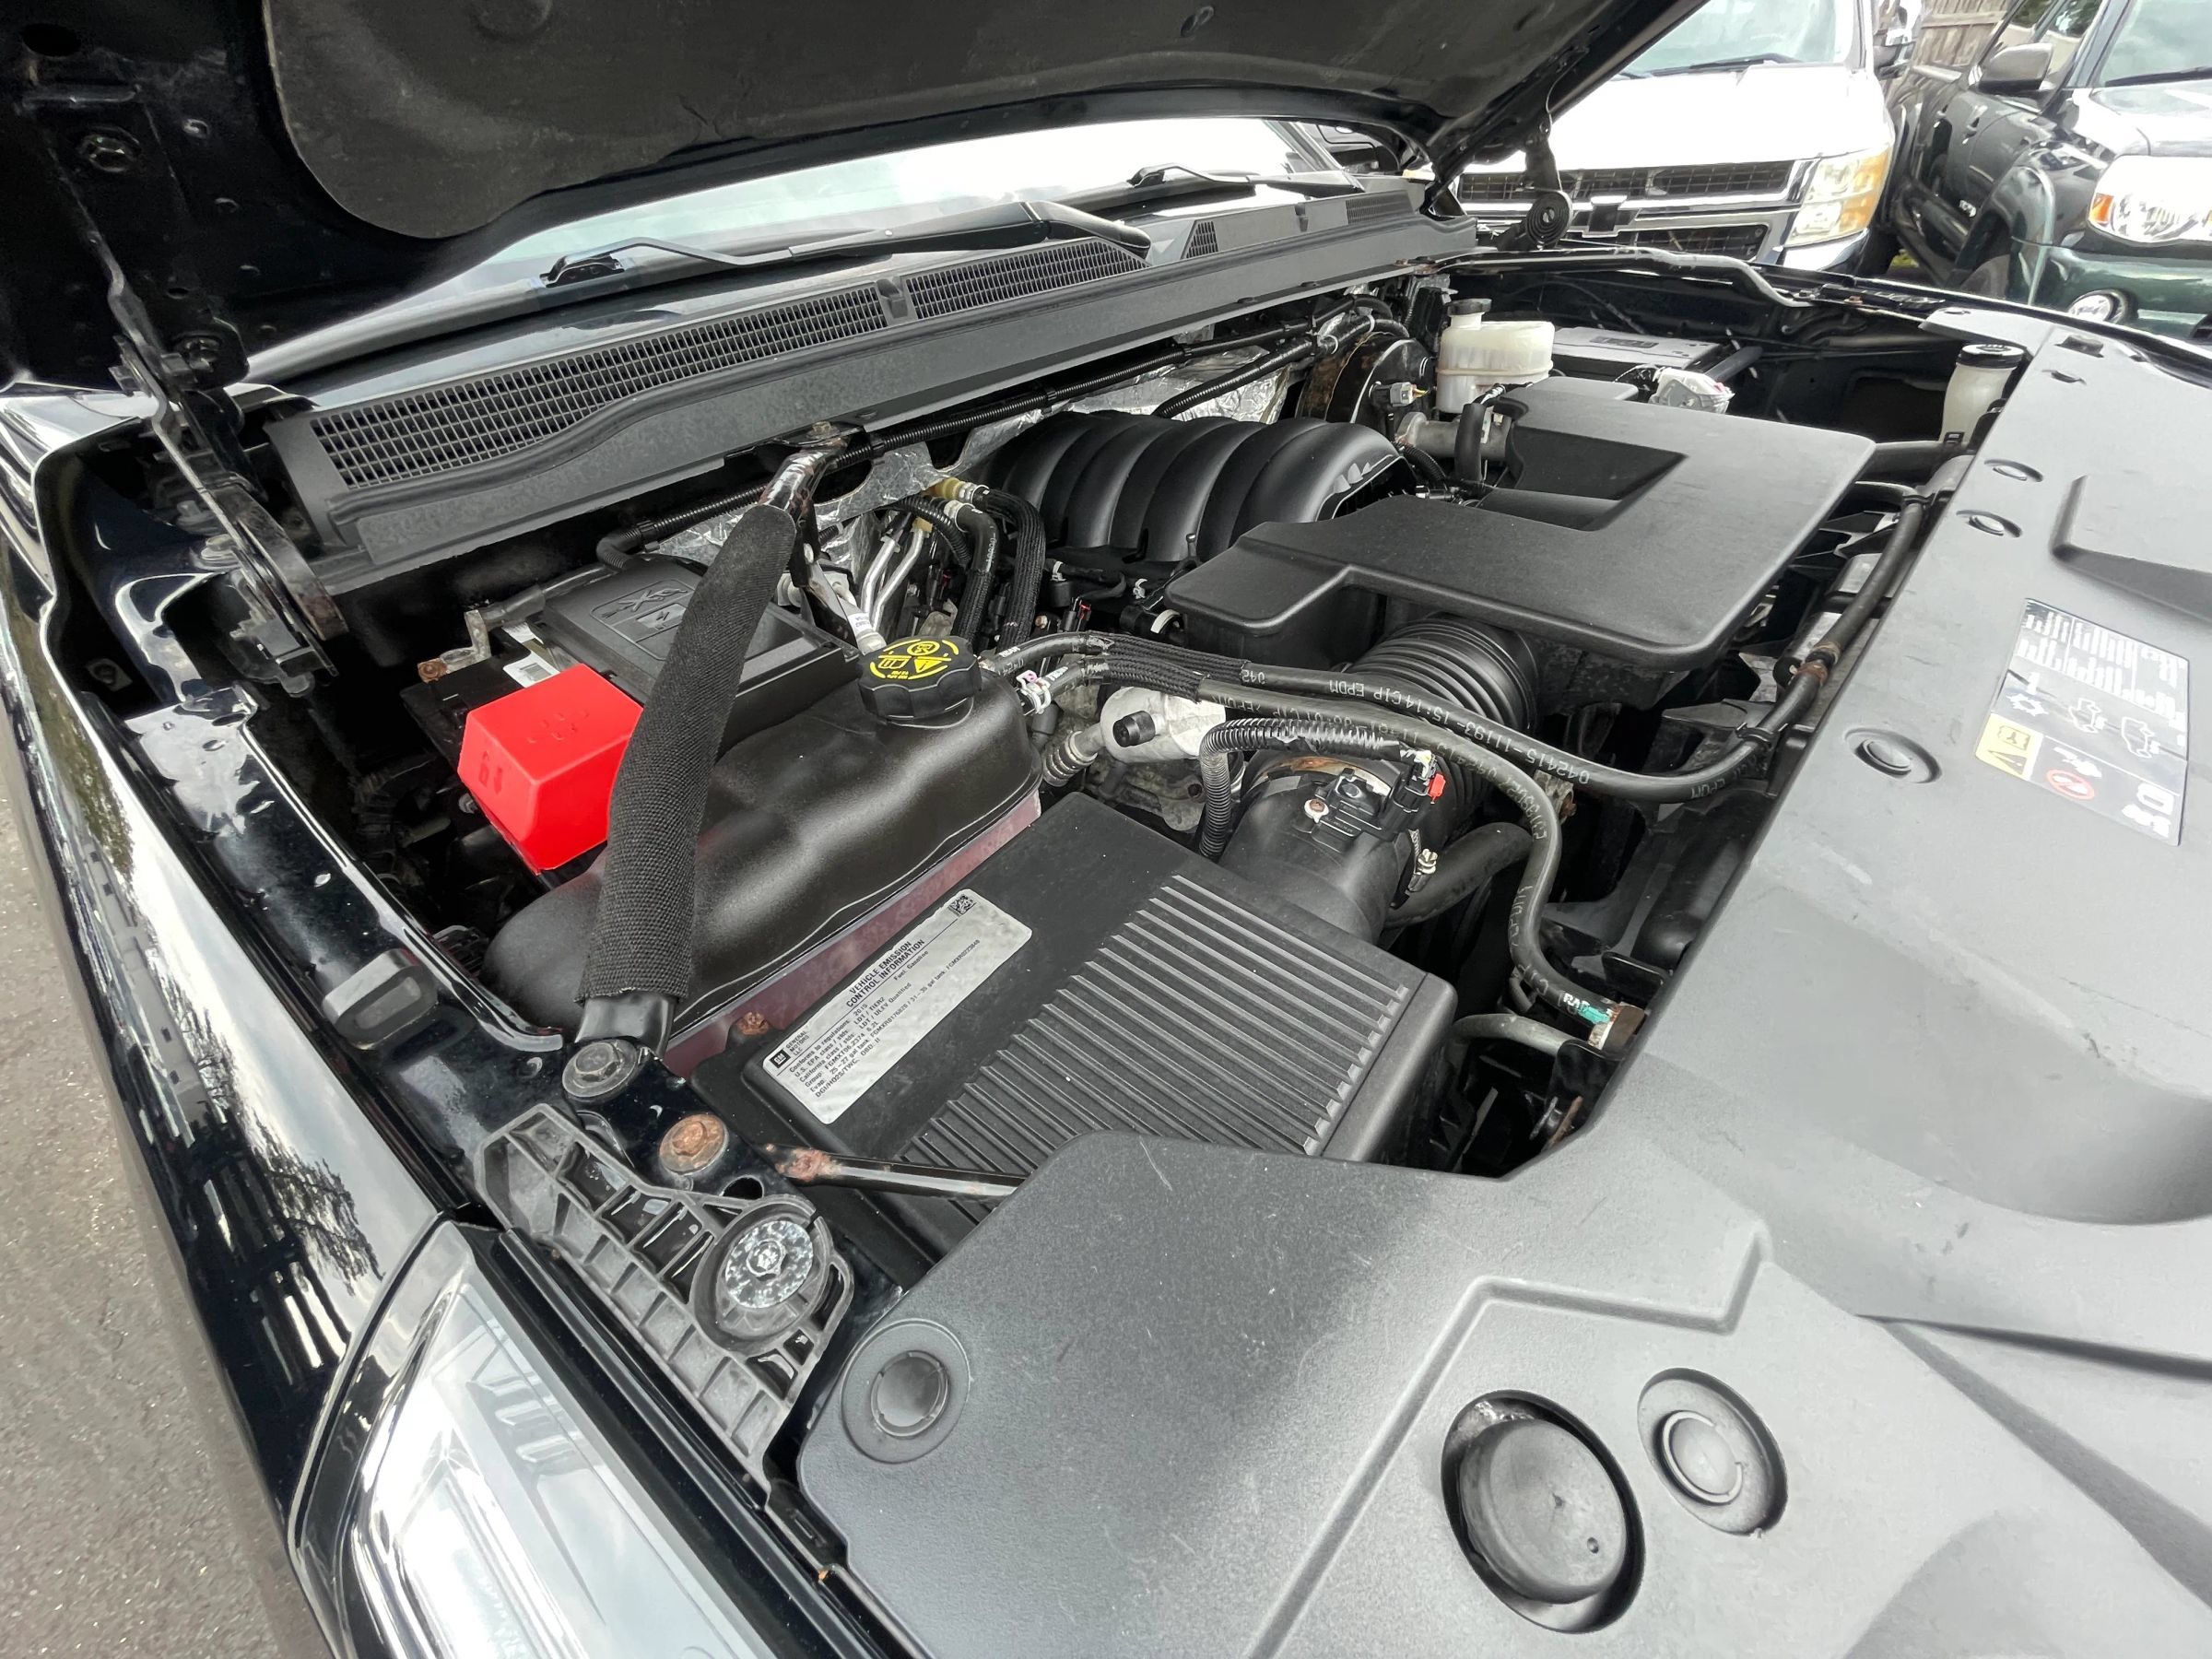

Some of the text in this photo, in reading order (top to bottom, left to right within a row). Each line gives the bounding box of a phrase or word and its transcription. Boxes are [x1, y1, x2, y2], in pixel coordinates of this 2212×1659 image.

[1329, 679, 1365, 697] EPDM
[845, 938, 924, 1007] CONTROL INFORMATION
[849, 940, 912, 994] VEHICLE EMISSION
[789, 1049, 815, 1073] Conforms
[853, 1003, 867, 1016] 2015
[906, 949, 928, 970] Gasoline
[785, 1030, 806, 1049] GENERAL
[789, 1034, 809, 1052] MOTORS
[794, 1065, 807, 1077] U.S.
[806, 1054, 819, 1065] EPA
[818, 1041, 833, 1055] class
[853, 1013, 865, 1025] LDT
[868, 996, 885, 1011] TIER2
[799, 1058, 826, 1082] California
[825, 1045, 840, 1059] class
[858, 1018, 871, 1029] LDT
[874, 1001, 888, 1016] ULEV
[888, 982, 912, 1004] Qualified
[793, 1047, 802, 1055] LLC
[848, 1048, 858, 1058] gal
